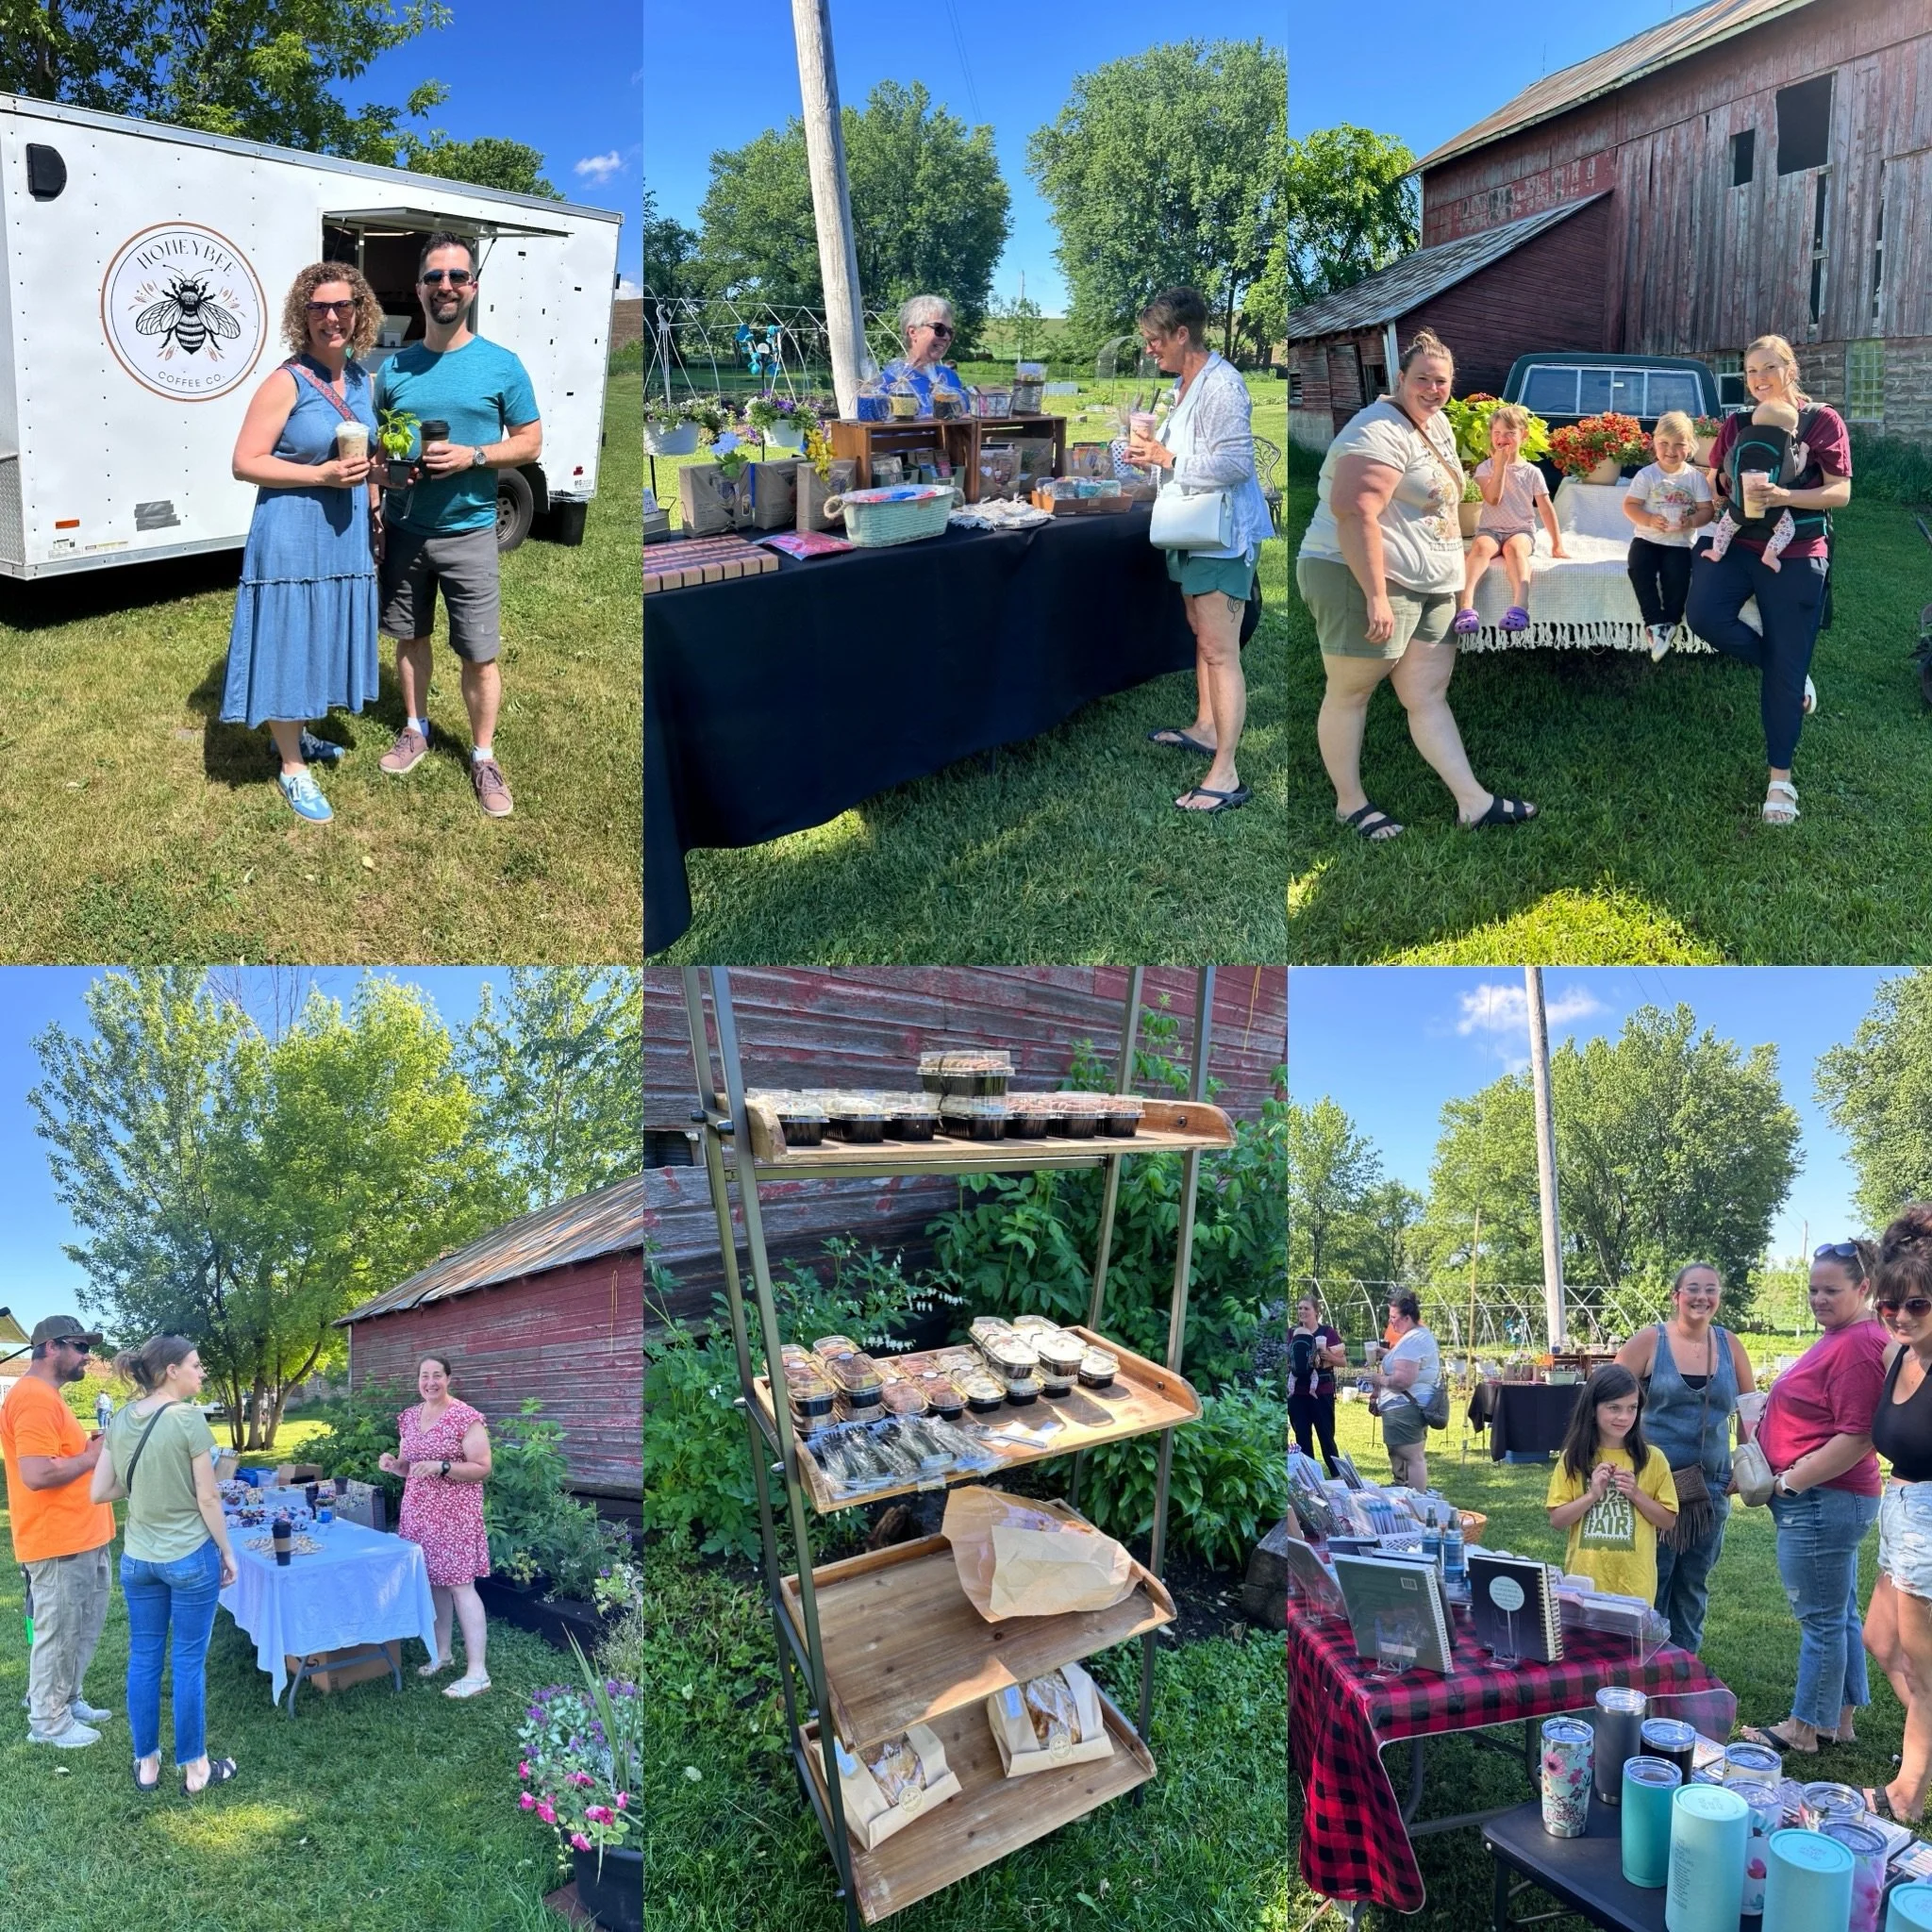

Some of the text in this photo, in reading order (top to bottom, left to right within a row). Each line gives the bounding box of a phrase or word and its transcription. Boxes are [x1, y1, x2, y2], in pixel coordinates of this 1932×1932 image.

[136, 239, 237, 277] HONEYBEE
[158, 371, 201, 388] COFFEE
[1588, 1516, 1629, 1536] FAIR
